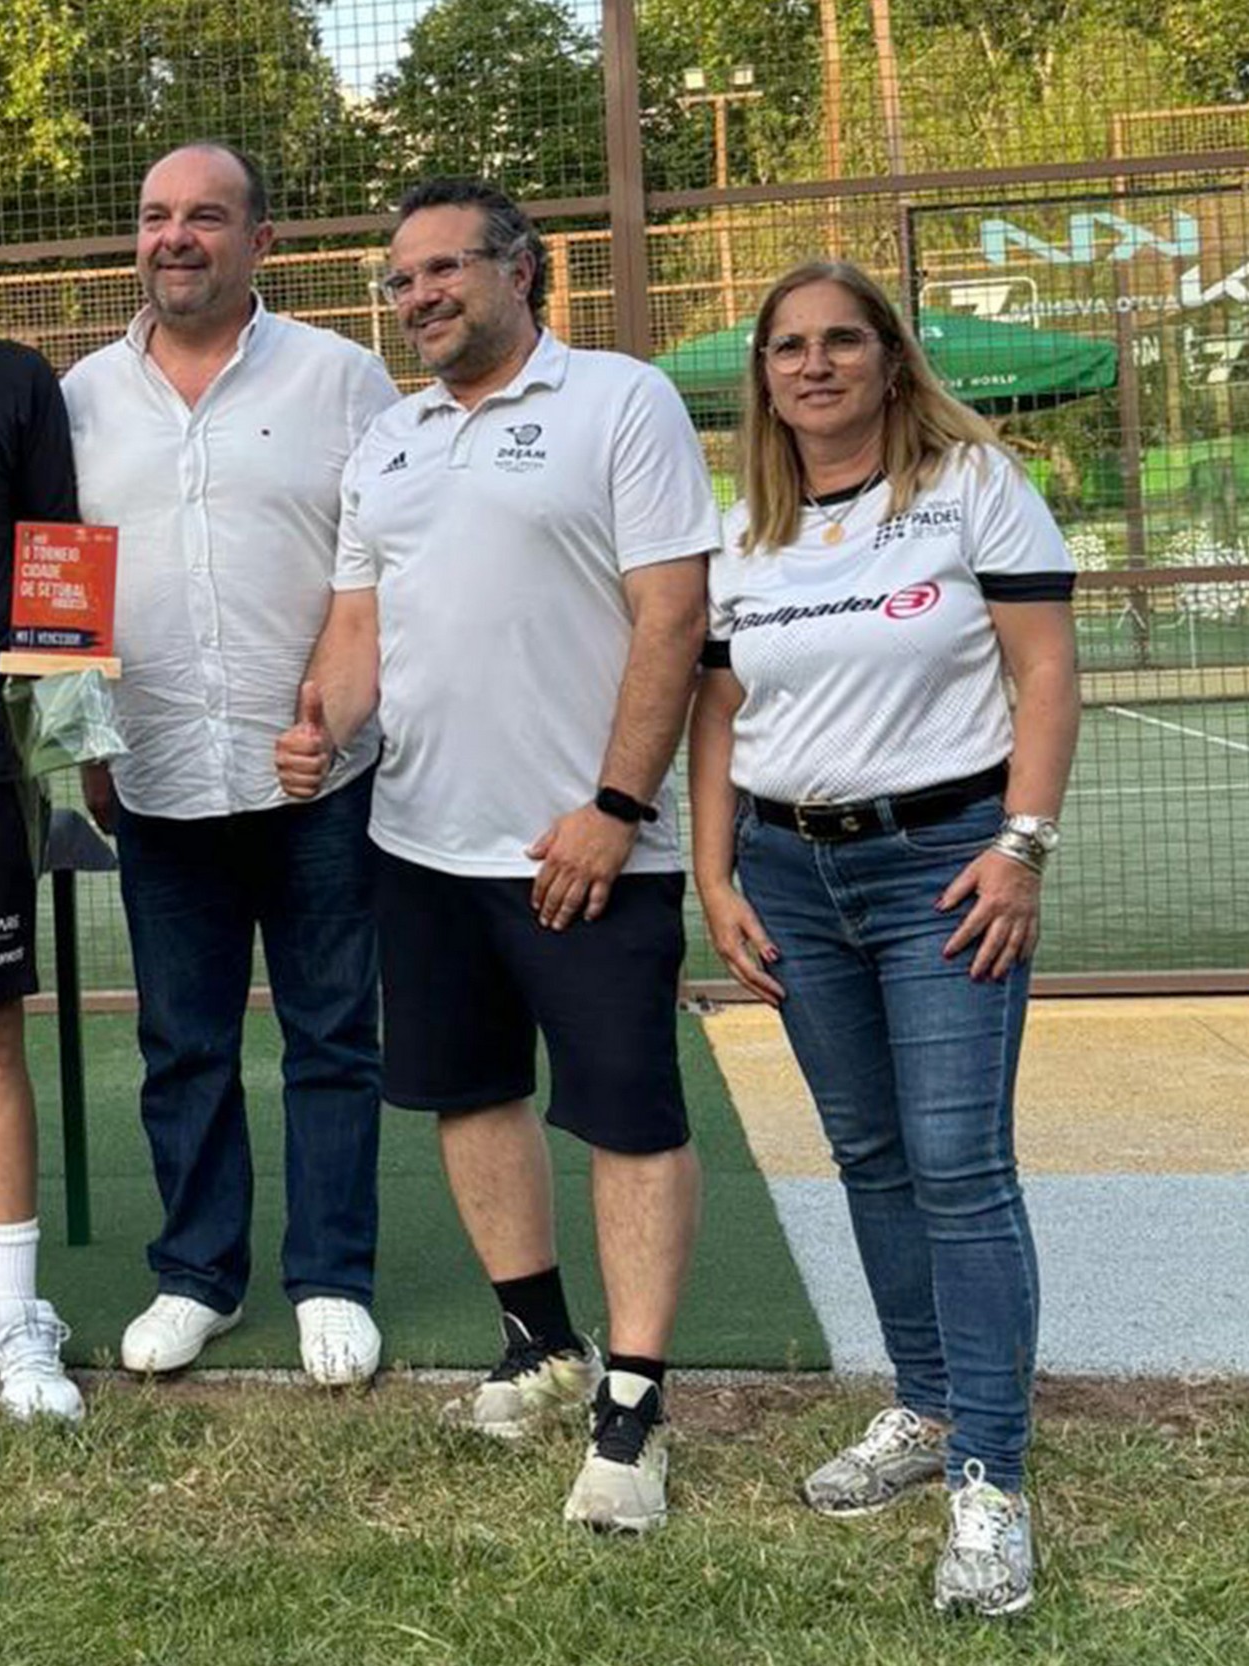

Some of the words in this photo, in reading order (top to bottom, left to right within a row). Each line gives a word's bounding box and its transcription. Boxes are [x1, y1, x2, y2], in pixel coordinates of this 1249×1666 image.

[971, 375, 1017, 386] WORLD
[911, 508, 962, 525] PADEL
[20, 580, 35, 597] DE
